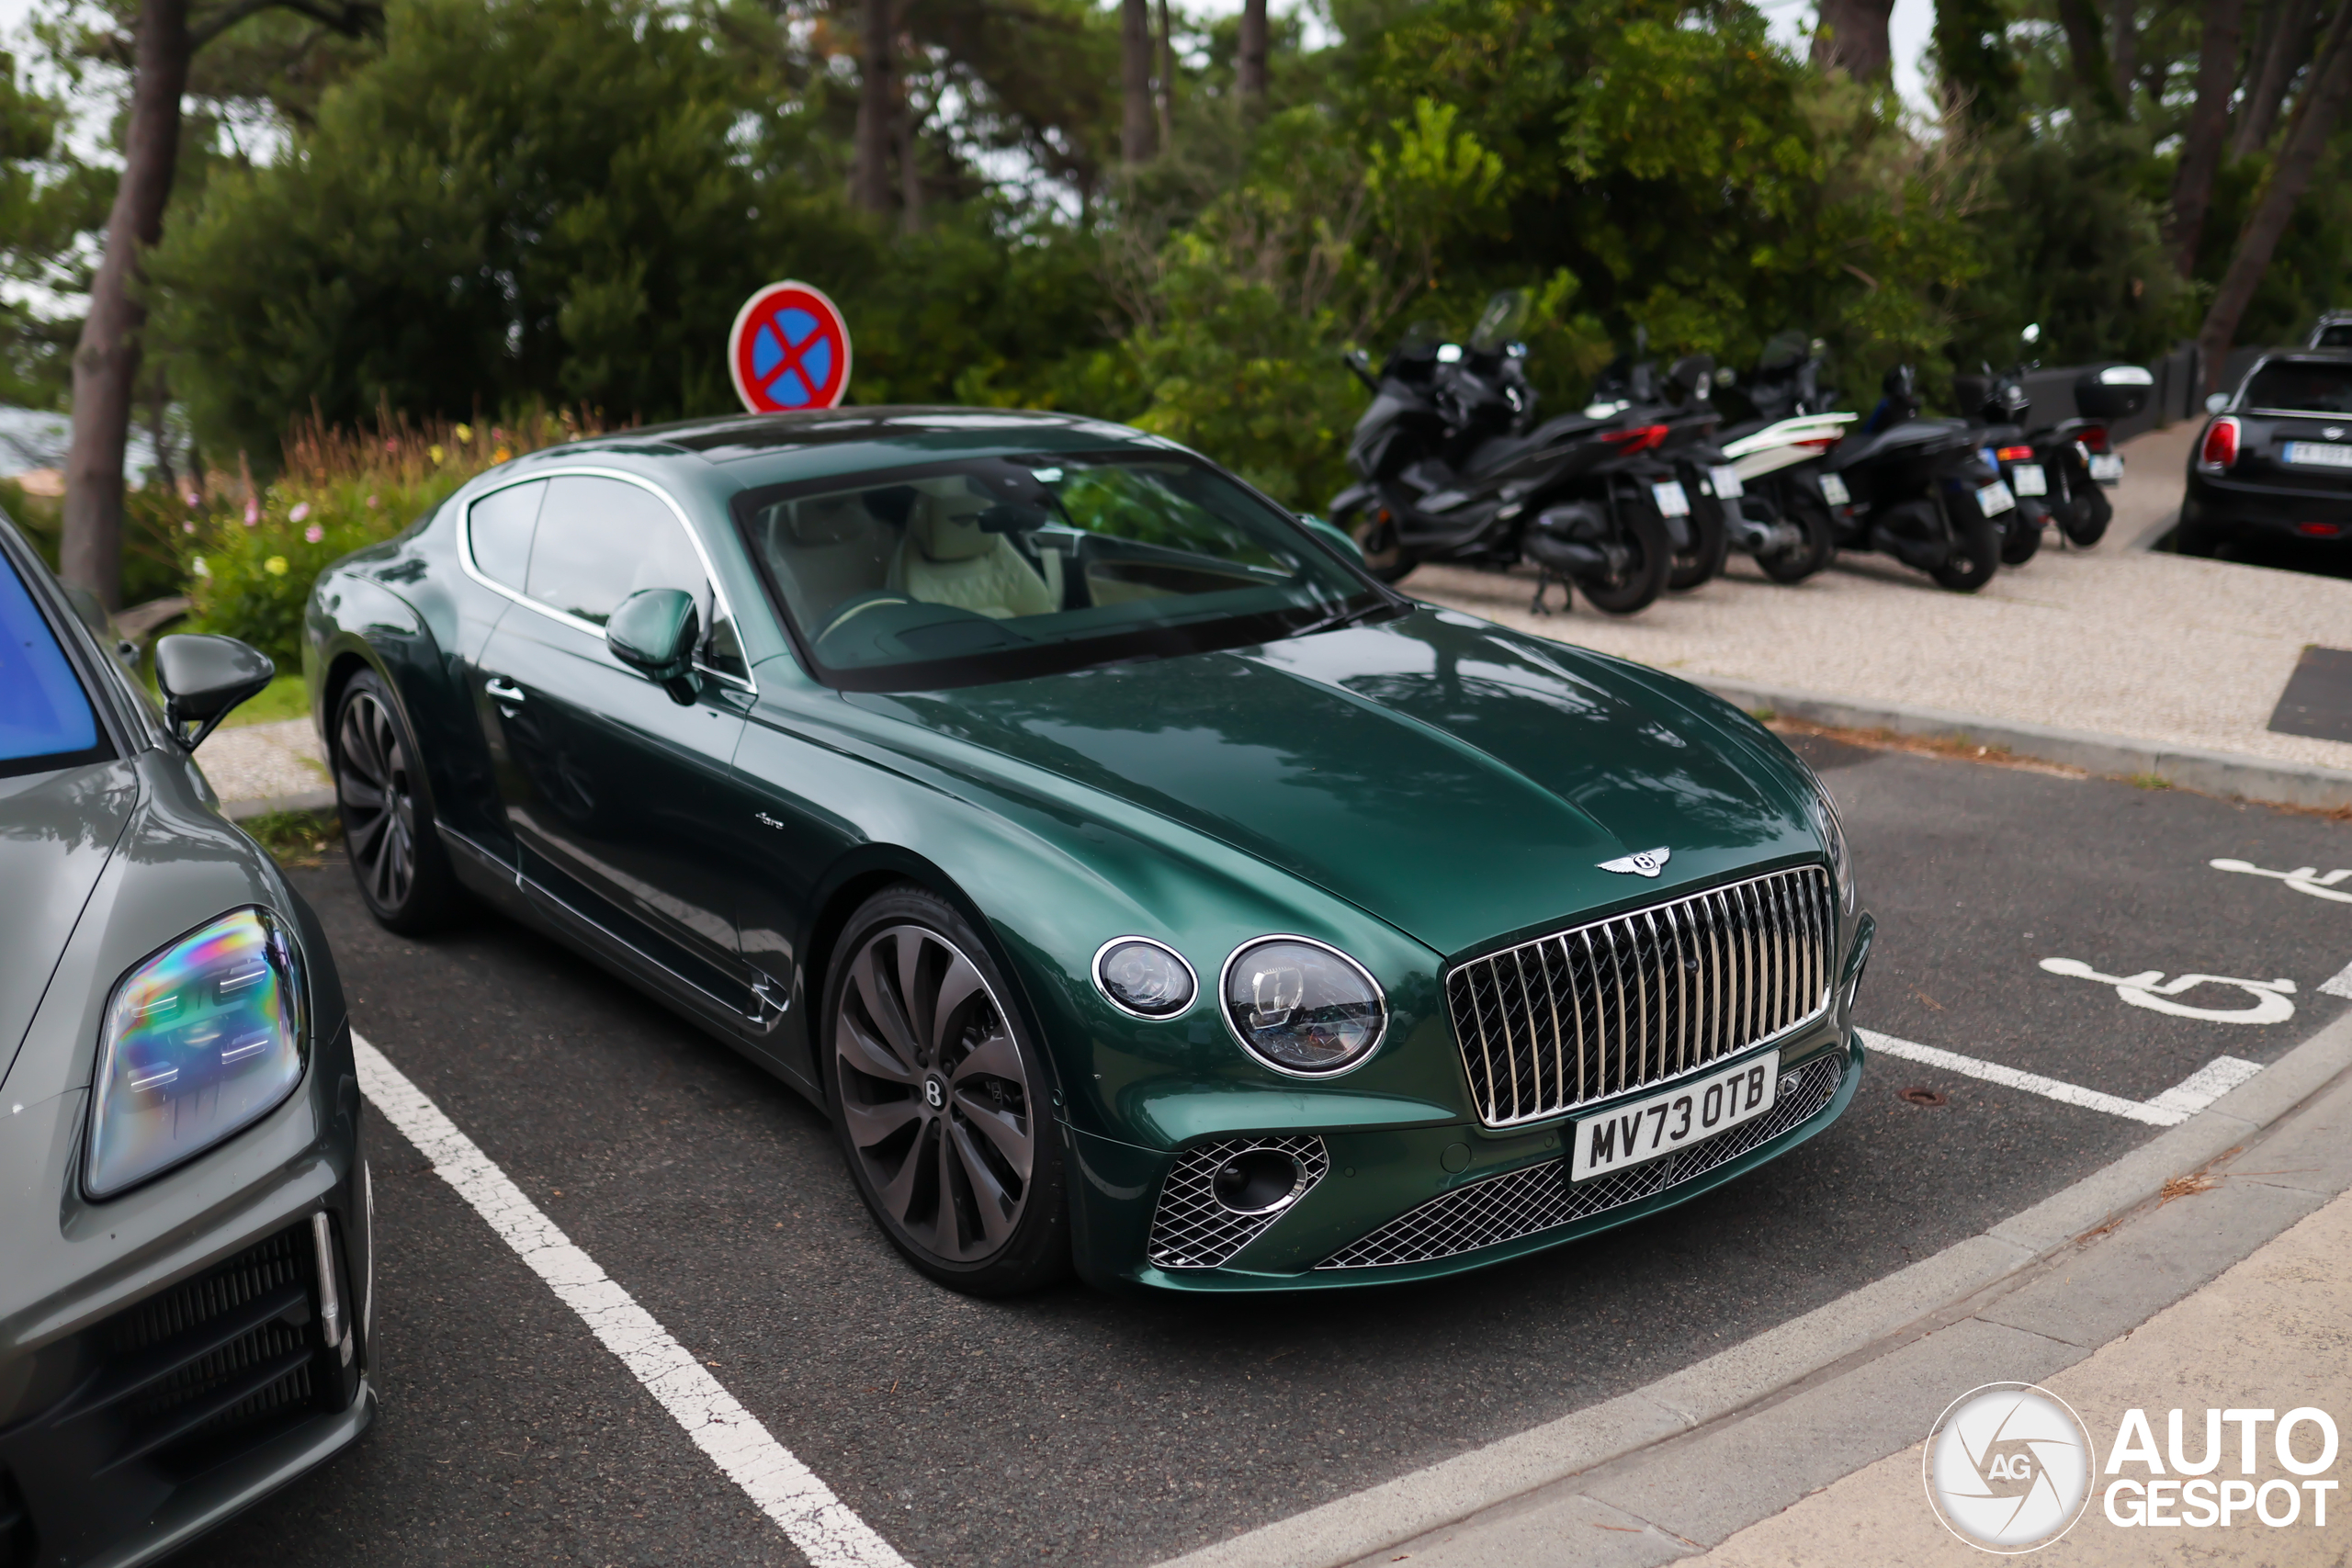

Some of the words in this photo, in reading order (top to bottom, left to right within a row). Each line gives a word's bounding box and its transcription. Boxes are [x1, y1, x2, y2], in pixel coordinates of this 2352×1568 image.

[925, 1080, 942, 1107] B
[1589, 1095, 1692, 1168] MV73
[1702, 1065, 1765, 1128] OTB
